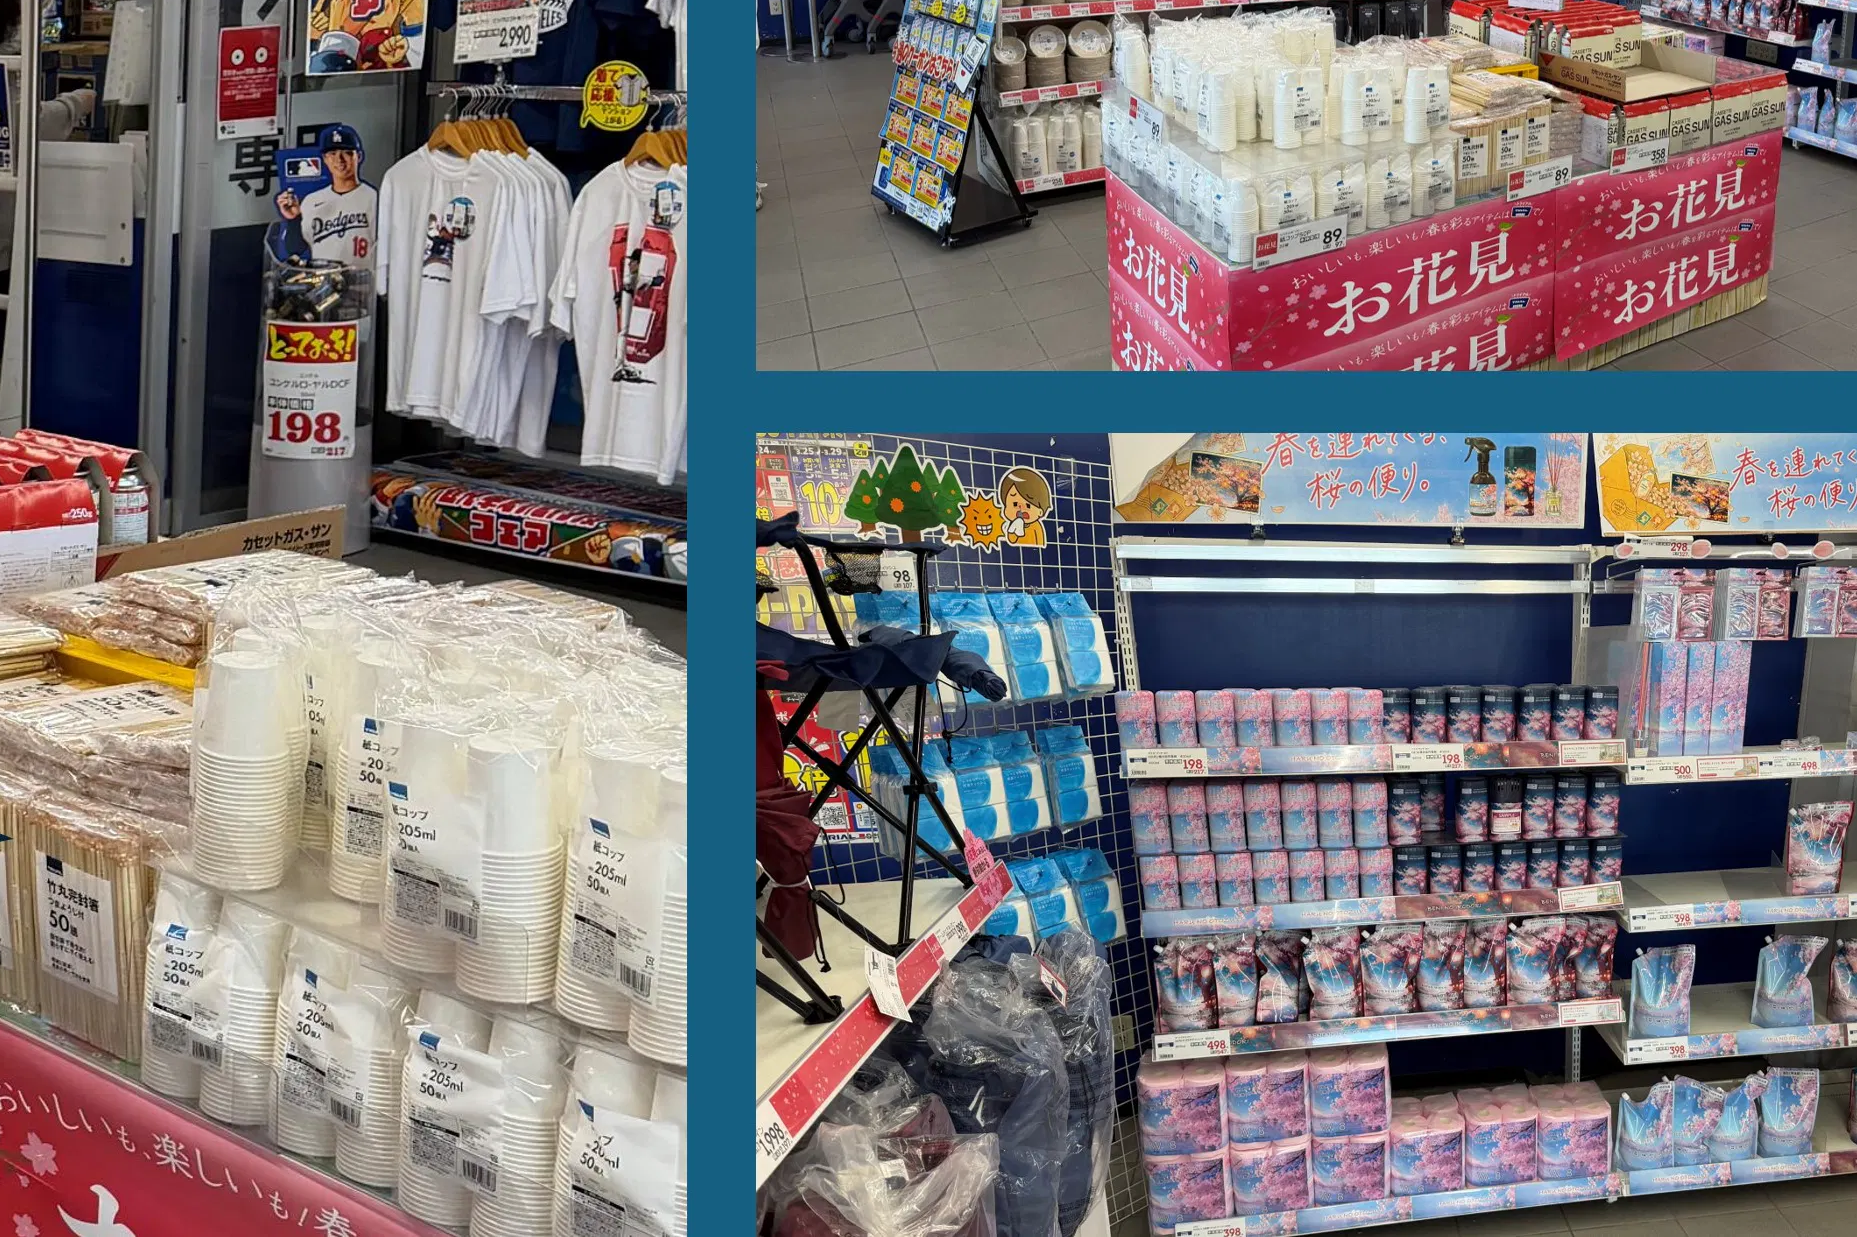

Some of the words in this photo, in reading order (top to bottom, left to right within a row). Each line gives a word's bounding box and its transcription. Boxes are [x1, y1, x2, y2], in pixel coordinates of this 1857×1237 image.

[500, 25, 530, 48] 2,990
[1152, 122, 1160, 136] 89
[1672, 124, 1691, 137] GAS
[1692, 119, 1710, 131] SUN
[1715, 115, 1732, 128] GAS
[1650, 148, 1666, 162] 358
[1555, 166, 1569, 181] 89
[1615, 167, 1746, 241] お花見
[312, 211, 369, 243] Dodgers
[1322, 227, 1342, 244] 89
[353, 236, 368, 258] 18
[1123, 228, 1190, 334] お花見
[1323, 230, 1516, 338] お花見
[1613, 242, 1740, 324] お花見
[267, 410, 341, 444] 198
[243, 523, 332, 550] カセットガス・サン
[1670, 542, 1687, 552] 298
[893, 570, 911, 582] 98
[1182, 759, 1203, 770] 198
[1442, 753, 1461, 764] 198
[1801, 760, 1819, 771] 498
[1673, 765, 1693, 775] 500
[1674, 914, 1691, 923] 398
[1207, 1040, 1227, 1050] 498
[1669, 1045, 1686, 1055] 398
[759, 1122, 786, 1157] 1,998
